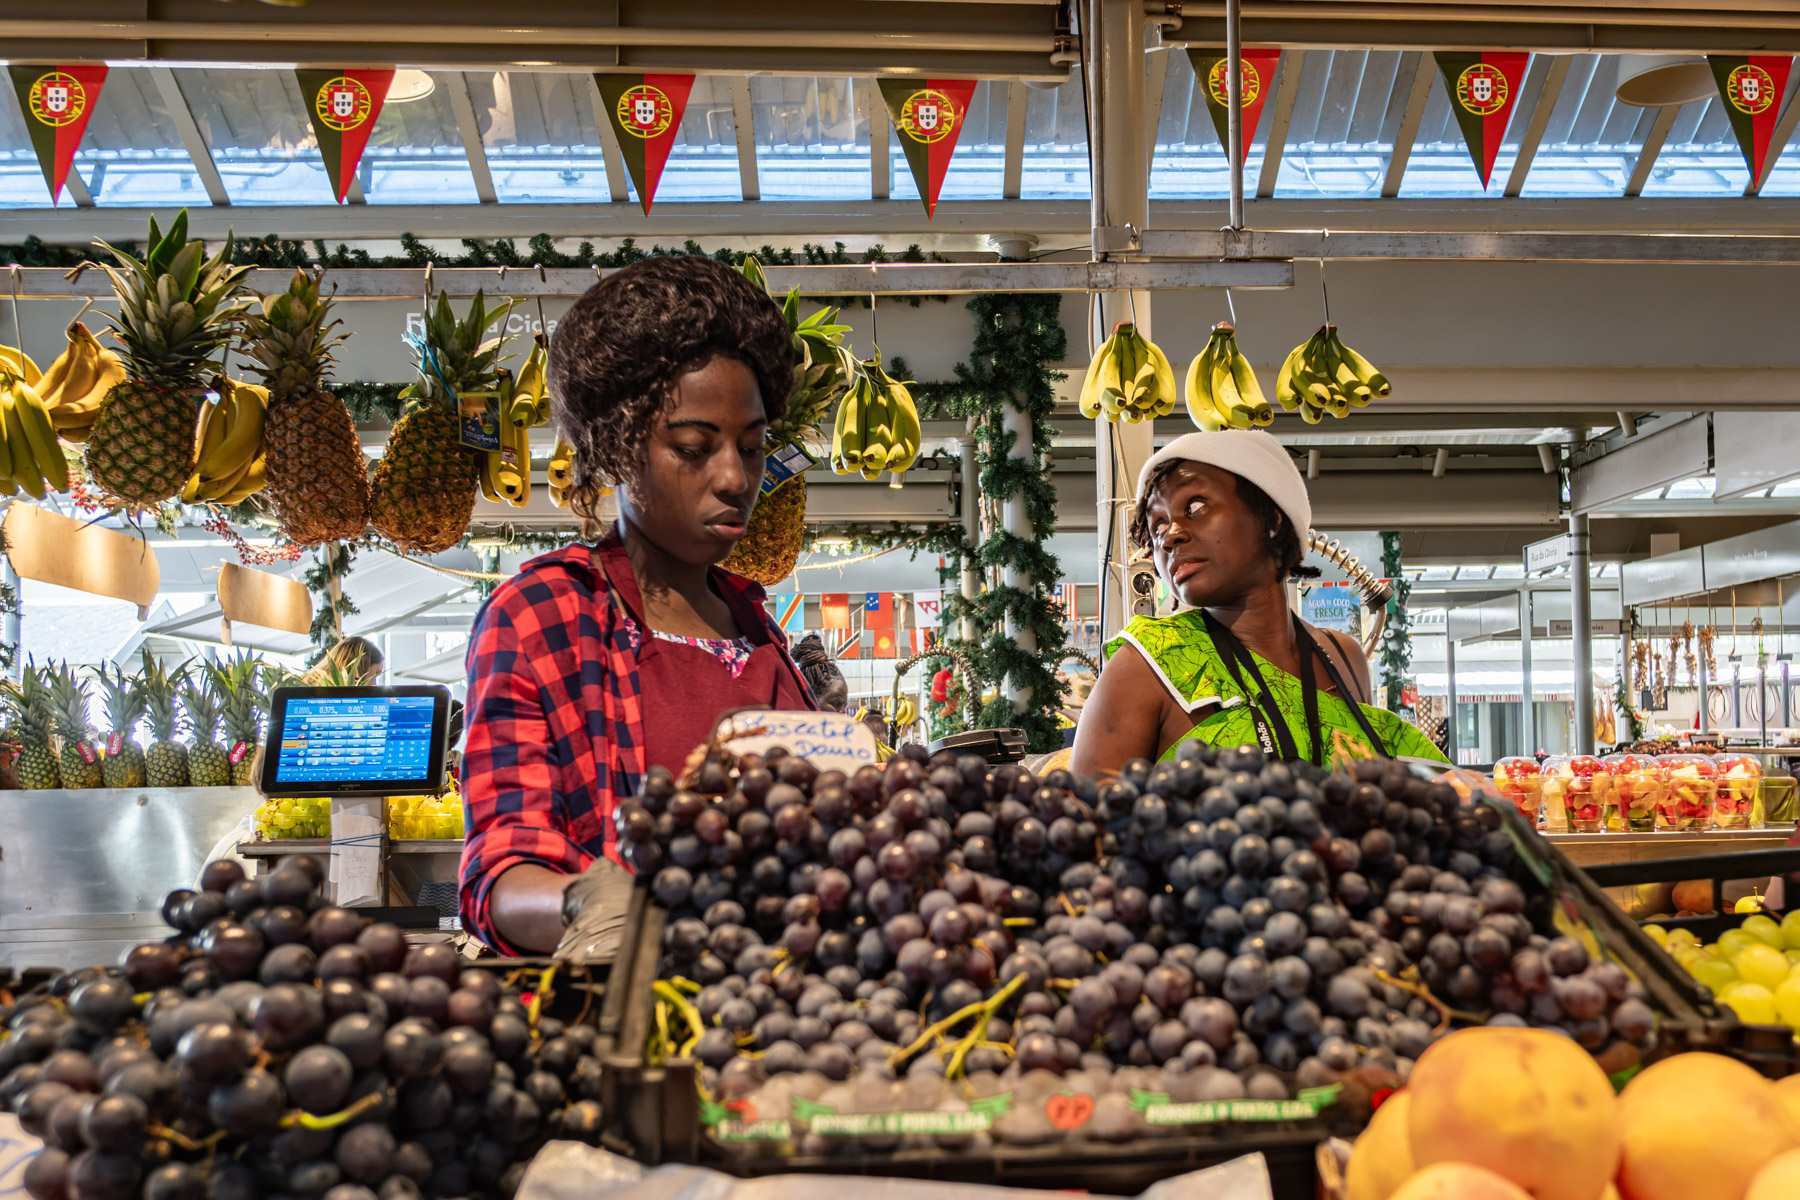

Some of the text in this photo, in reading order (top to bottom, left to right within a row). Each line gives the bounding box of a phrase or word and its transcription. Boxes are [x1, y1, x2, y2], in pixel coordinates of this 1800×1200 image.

[505, 312, 559, 334] Cida
[1531, 552, 1539, 562] Rua
[1333, 598, 1350, 607] COCO
[1314, 607, 1344, 619] FRESCA
[1555, 624, 1568, 632] Rua
[1257, 721, 1274, 754] Bolhão
[232, 742, 247, 763] plump
